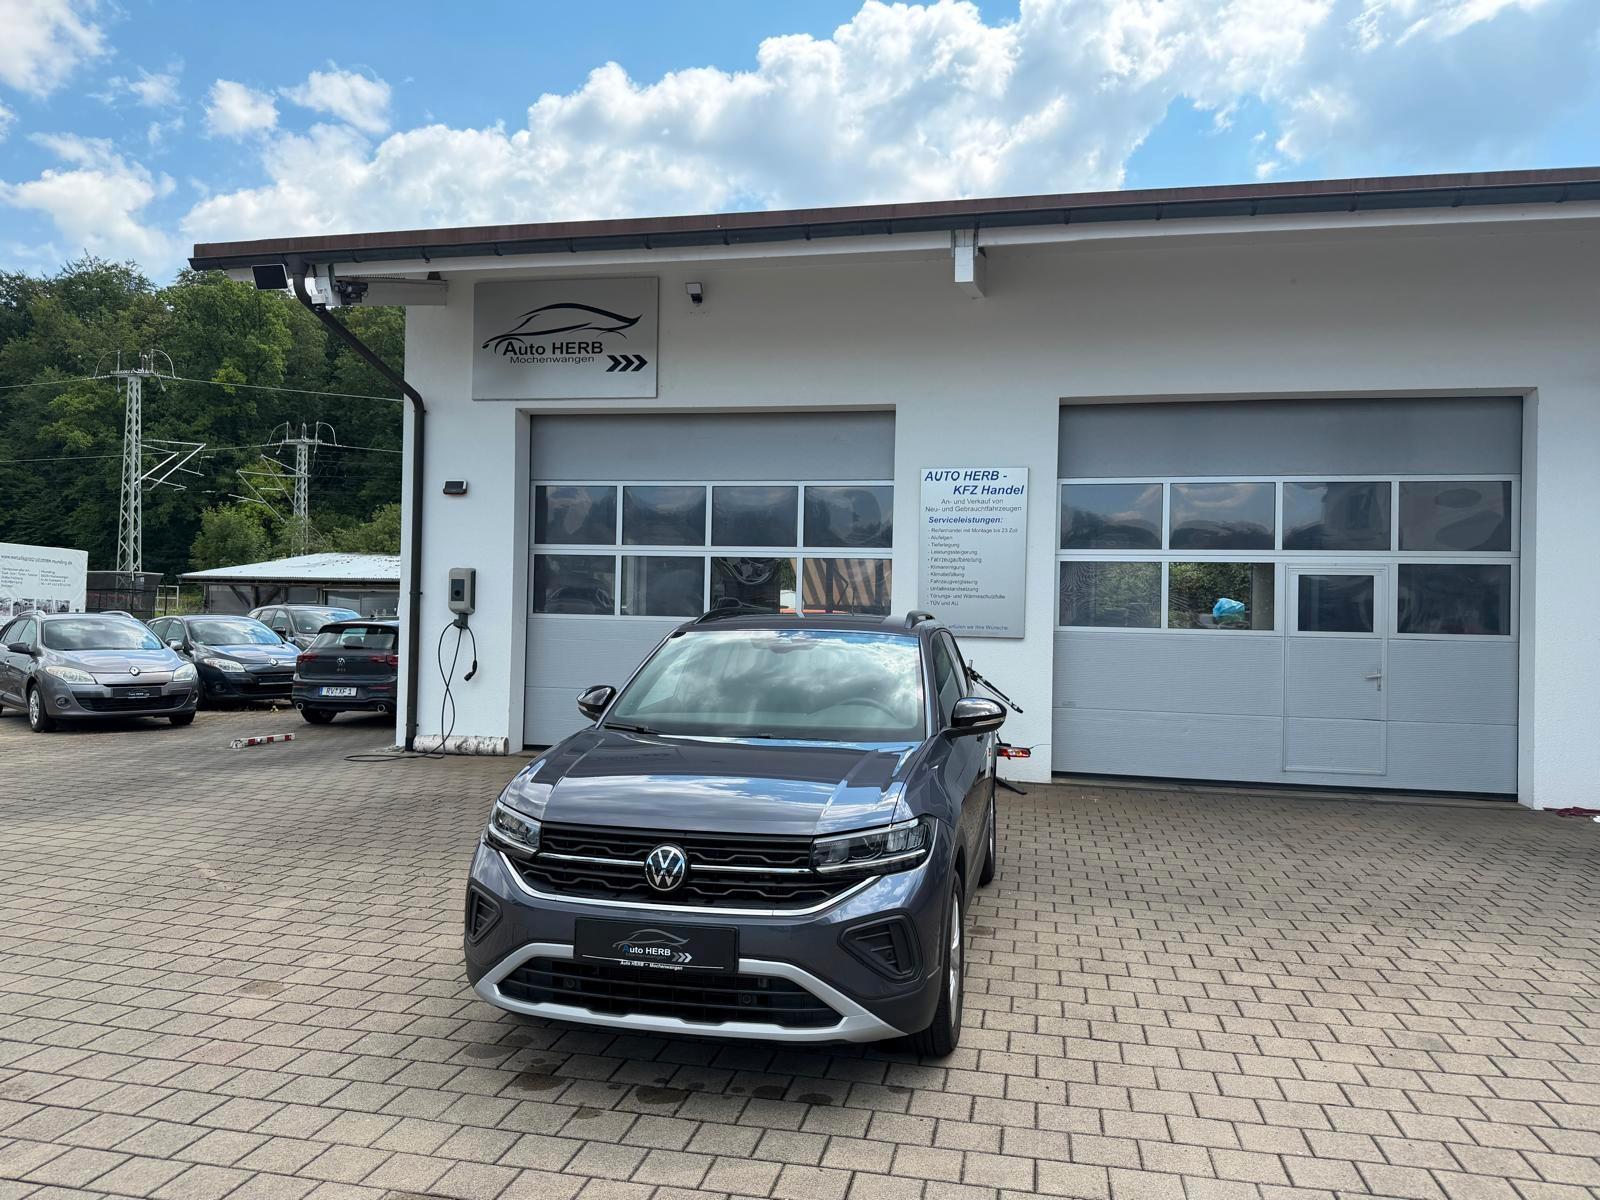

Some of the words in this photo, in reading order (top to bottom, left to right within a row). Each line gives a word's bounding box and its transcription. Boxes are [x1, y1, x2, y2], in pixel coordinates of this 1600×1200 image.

[503, 341, 546, 356] Auto
[552, 341, 604, 355] HERB
[510, 355, 595, 365] Mochenwangen
[925, 470, 961, 482] AUTO
[963, 470, 1000, 481] HERB
[953, 485, 979, 495] KFZ
[981, 484, 1025, 495] Handel
[954, 505, 1022, 513] Gebrauchtfahrzeugen
[928, 516, 1003, 524] Serviceleistungen:
[623, 944, 644, 955] Auto
[645, 947, 671, 956] HERB
